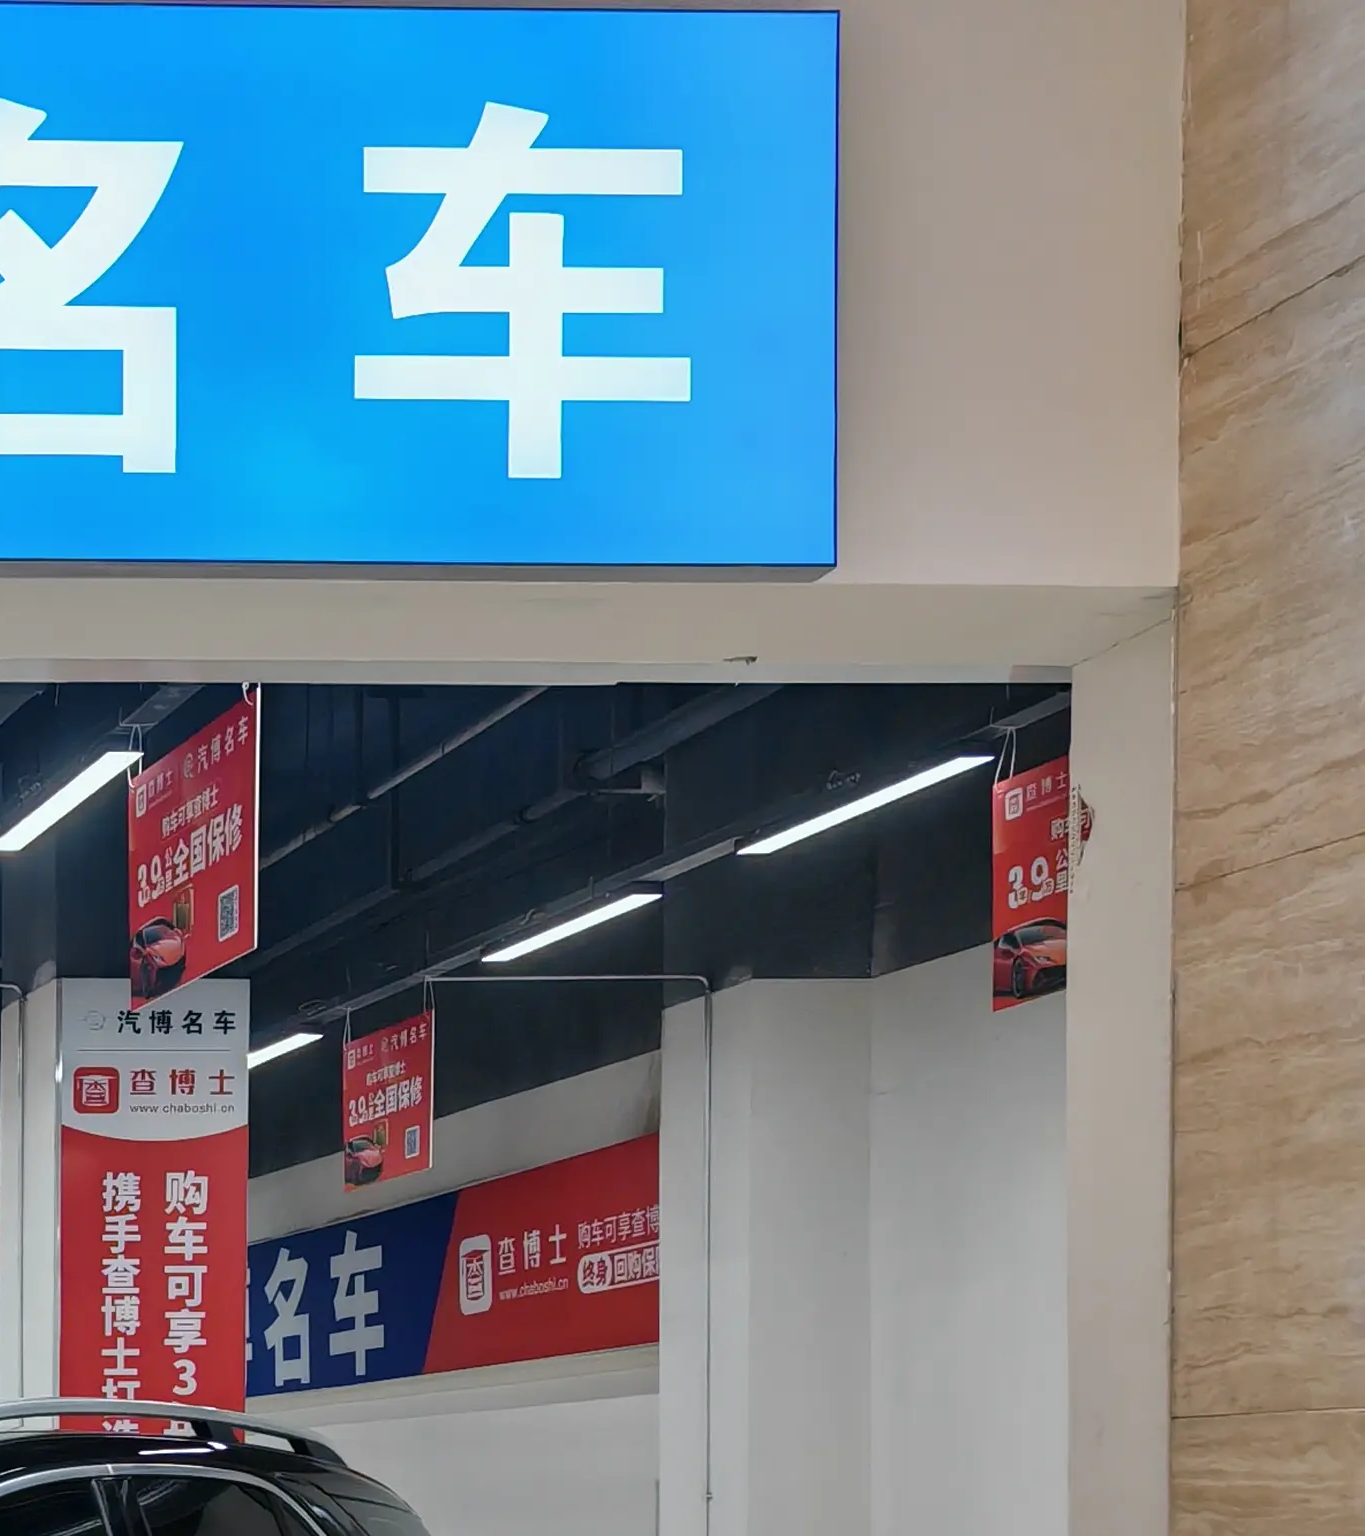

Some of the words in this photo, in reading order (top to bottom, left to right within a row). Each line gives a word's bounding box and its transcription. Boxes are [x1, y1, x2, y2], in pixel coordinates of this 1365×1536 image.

[197, 715, 249, 775] 汽博名车
[117, 1010, 236, 1035] 汽博名车
[130, 1069, 235, 1096] 查博士
[130, 1103, 235, 1114] www.chaboshi.cn
[498, 1224, 567, 1276] 查博士
[164, 1170, 209, 1436] 购车可享3
[246, 1230, 385, 1387] 名车
